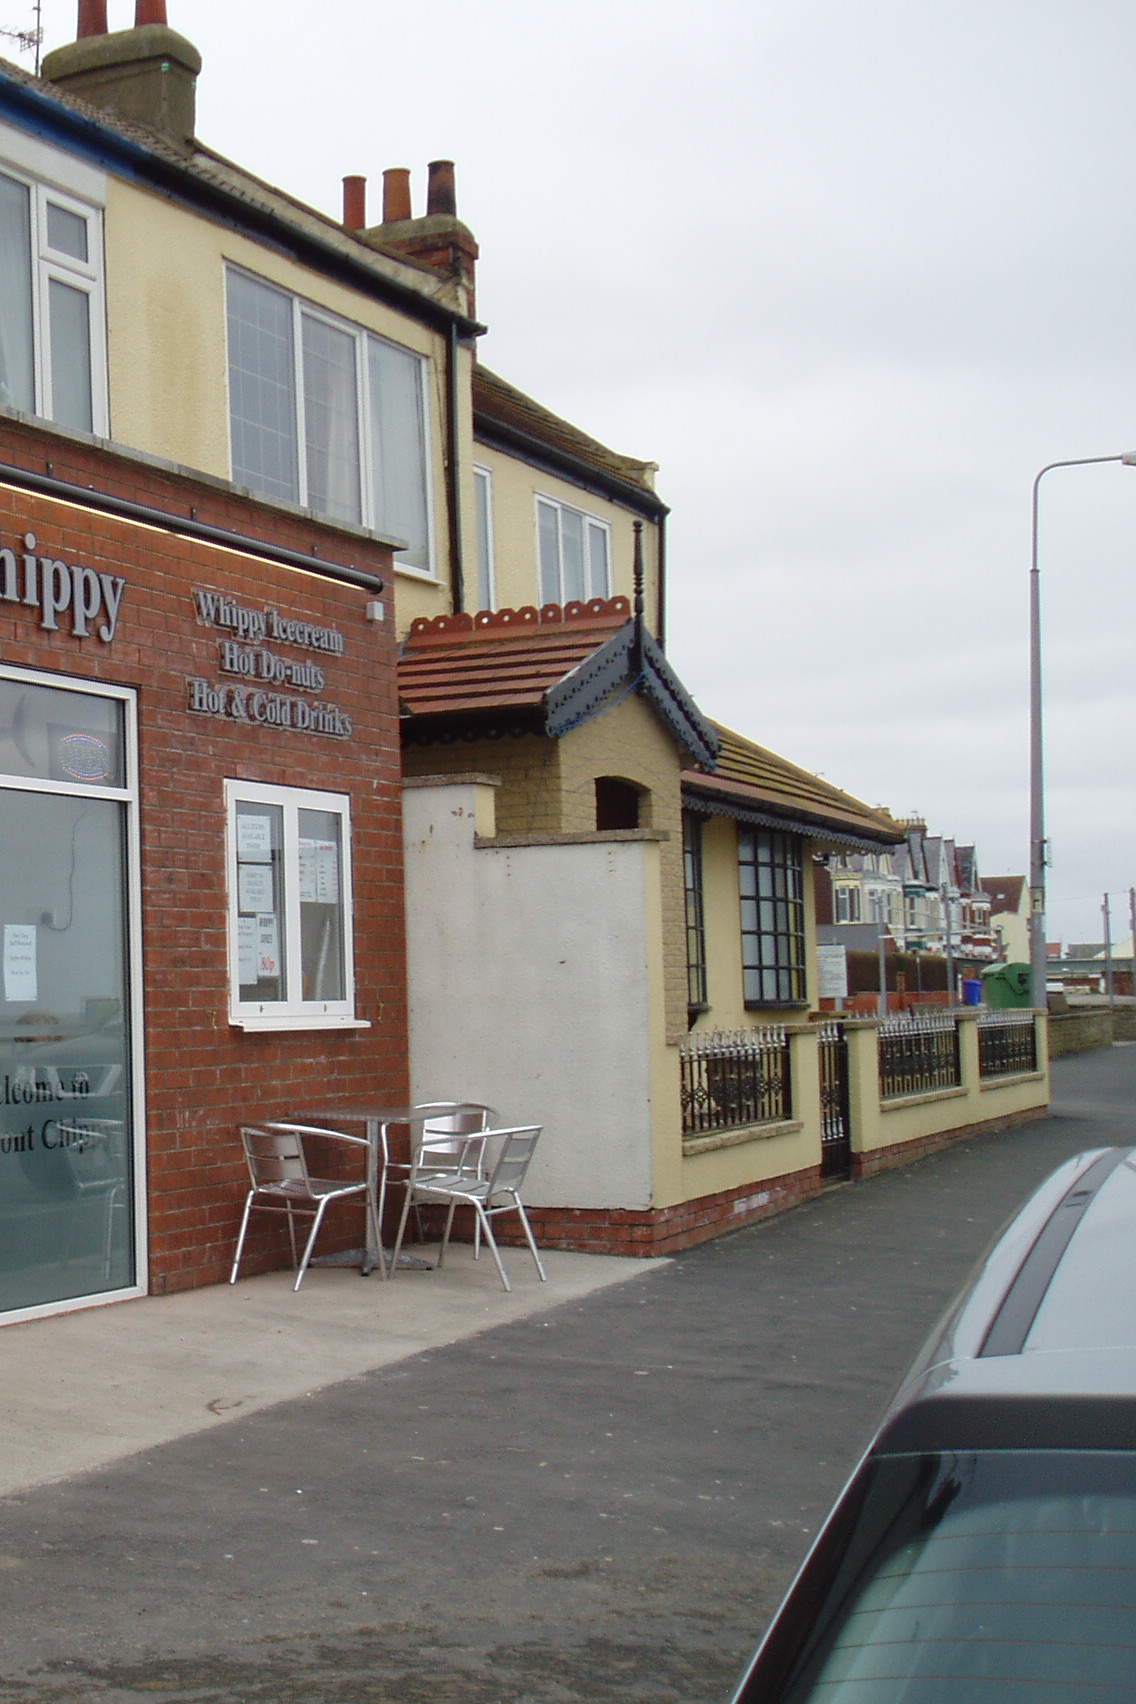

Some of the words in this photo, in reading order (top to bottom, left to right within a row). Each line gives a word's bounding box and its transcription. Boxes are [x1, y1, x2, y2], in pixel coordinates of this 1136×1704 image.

[194, 588, 267, 642] Whippy
[270, 608, 345, 653] Icecream
[221, 640, 257, 676] Hot
[262, 650, 325, 691] Do-nuts
[191, 679, 227, 714] Hot
[230, 688, 247, 718] &
[253, 692, 292, 727] Cold
[296, 699, 353, 737] Drinks
